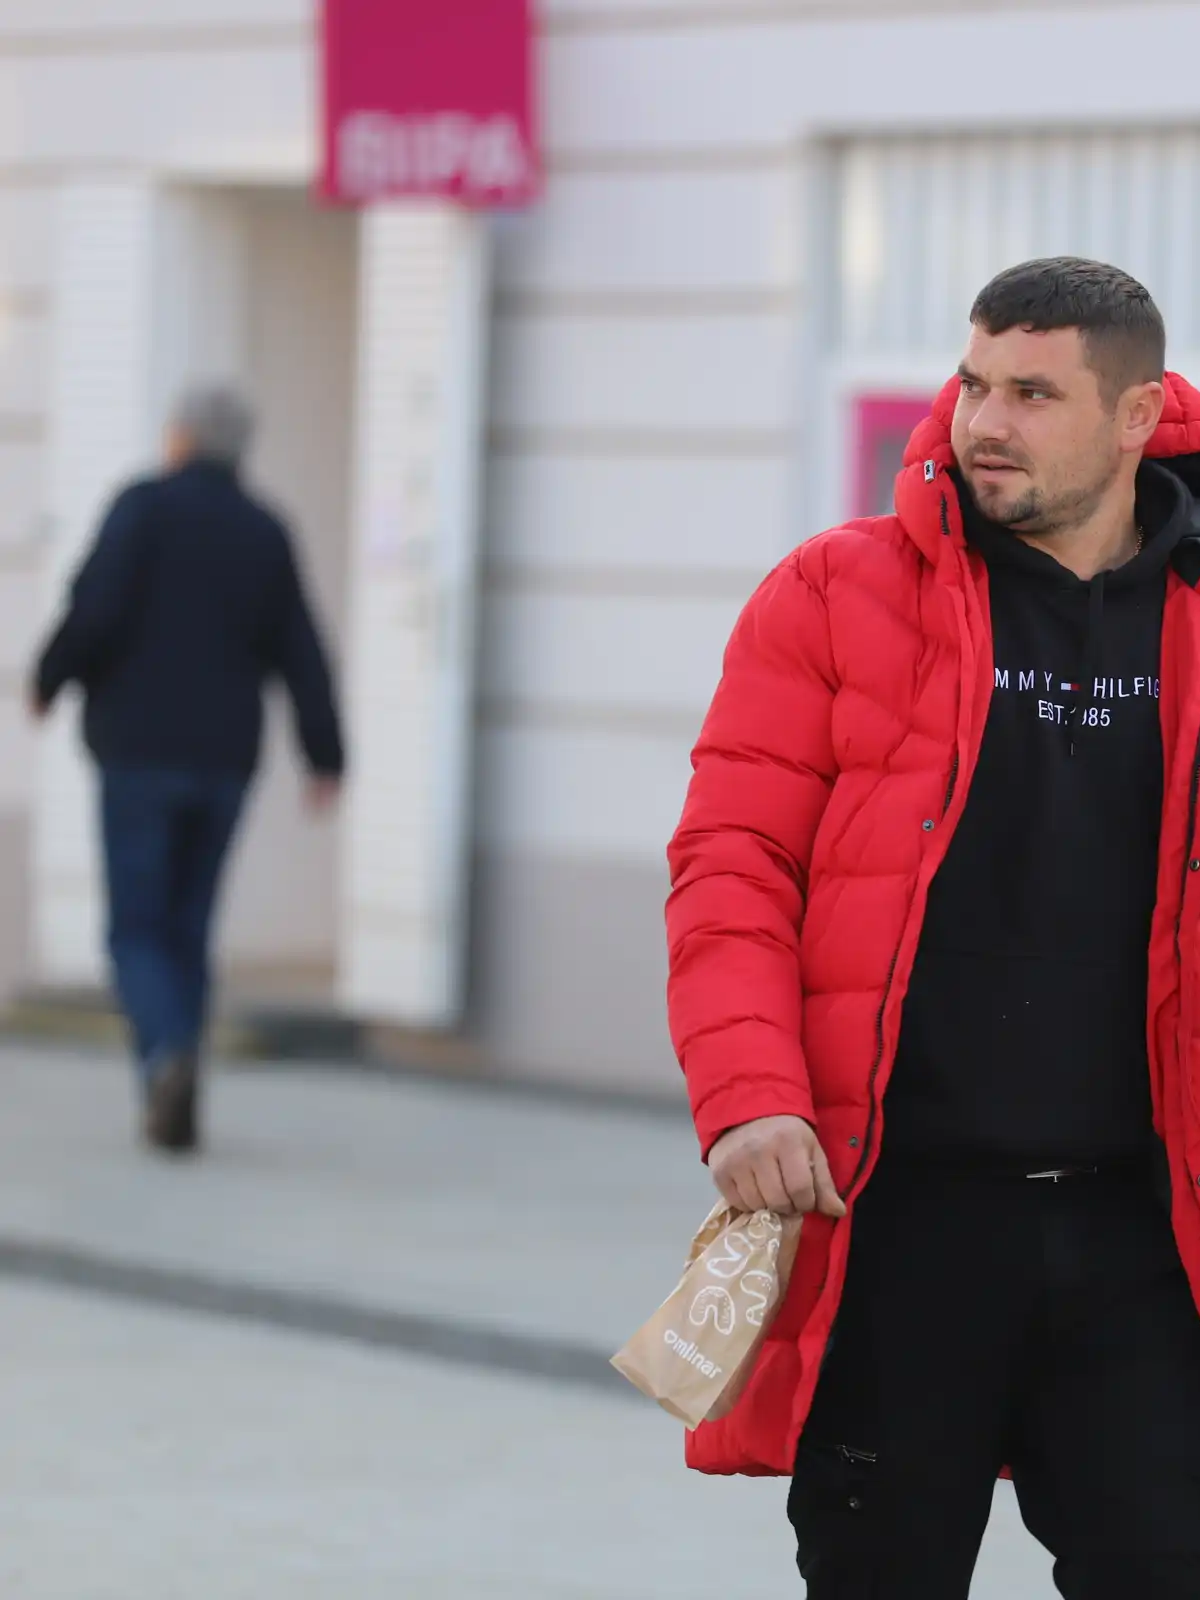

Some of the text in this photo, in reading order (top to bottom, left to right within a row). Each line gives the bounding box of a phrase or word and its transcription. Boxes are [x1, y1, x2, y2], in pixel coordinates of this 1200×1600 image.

[994, 667, 1160, 699] MMY HILFIG
[1038, 699, 1068, 726] EST.
